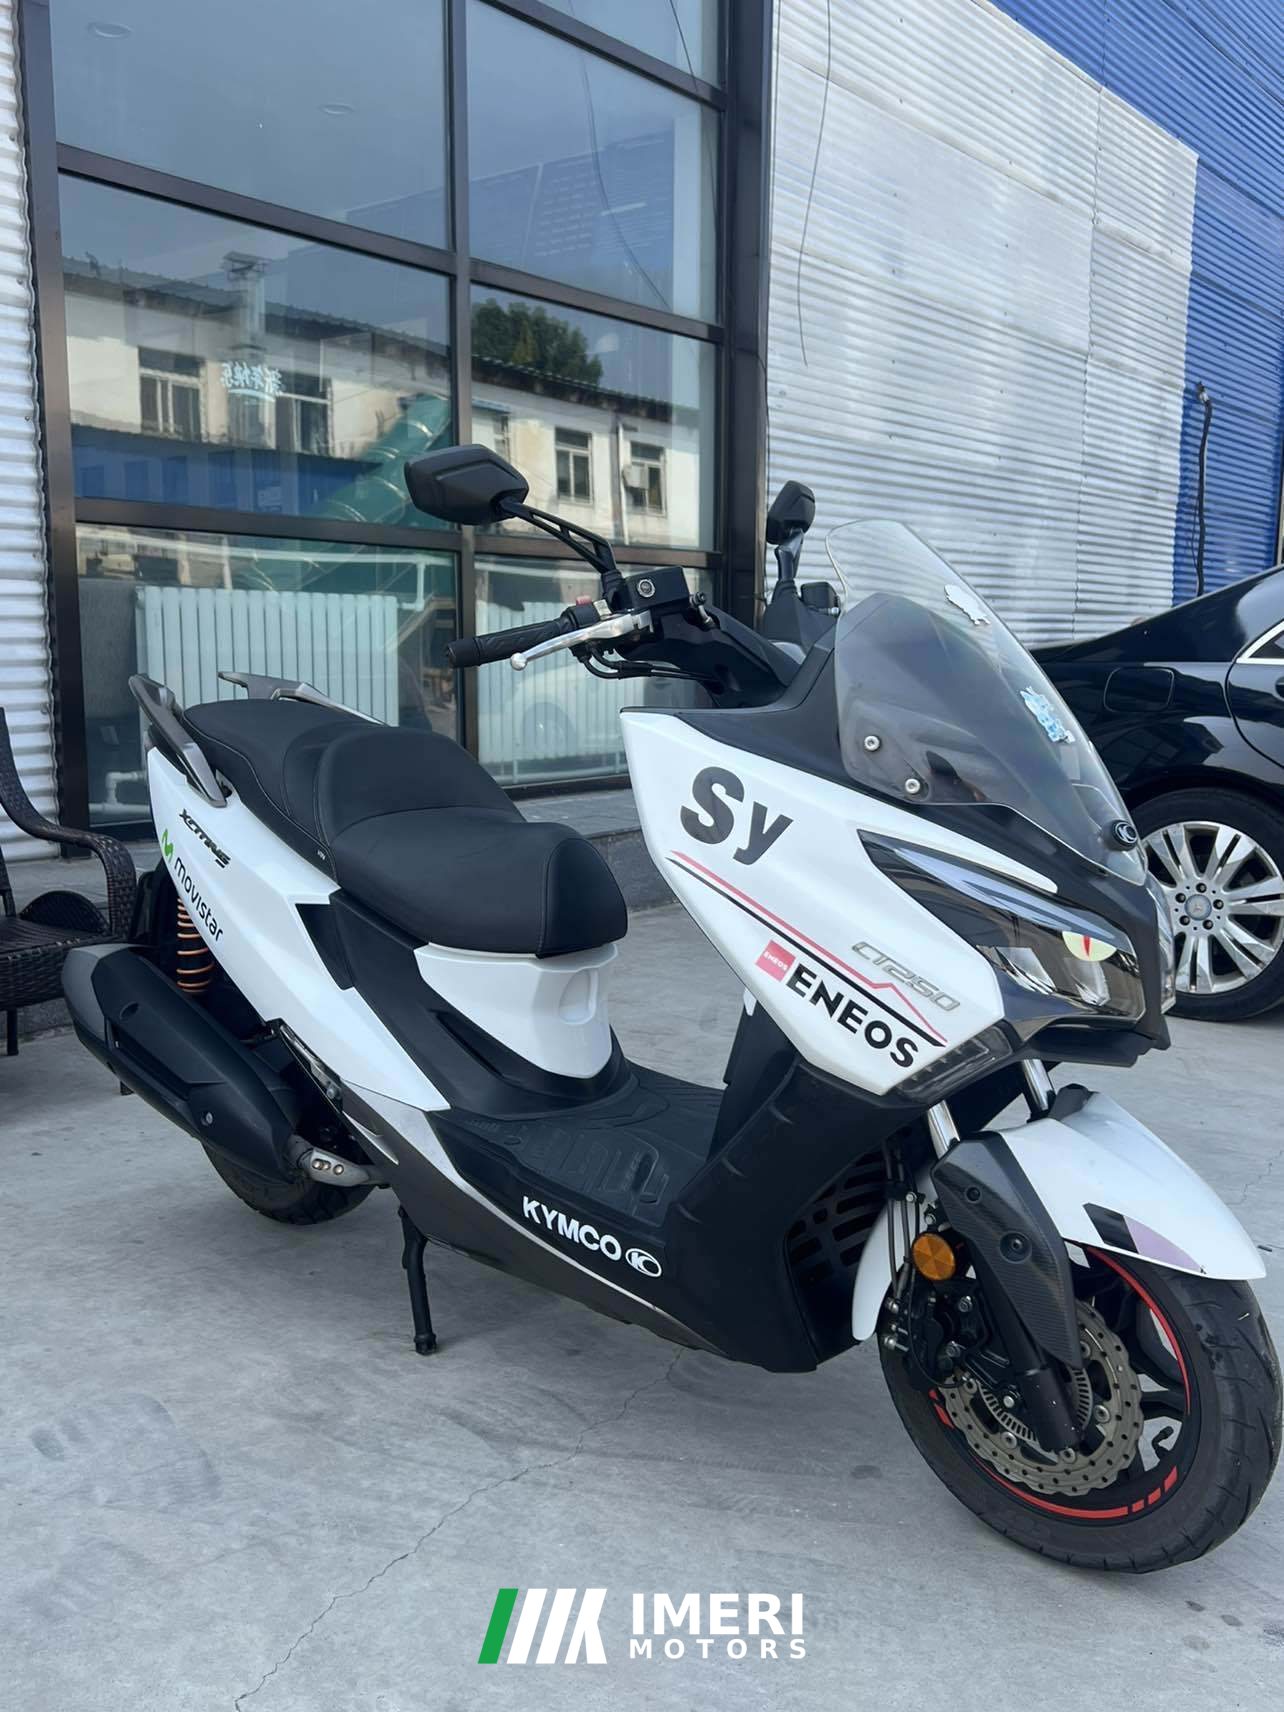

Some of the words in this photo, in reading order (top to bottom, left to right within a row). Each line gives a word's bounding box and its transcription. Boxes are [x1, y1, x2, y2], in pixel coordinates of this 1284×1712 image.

[680, 766, 794, 865] Sy
[174, 857, 224, 941] movistar
[786, 963, 919, 1067] ENEOS
[852, 941, 961, 1012] CT250
[522, 1196, 622, 1261] KYMCO
